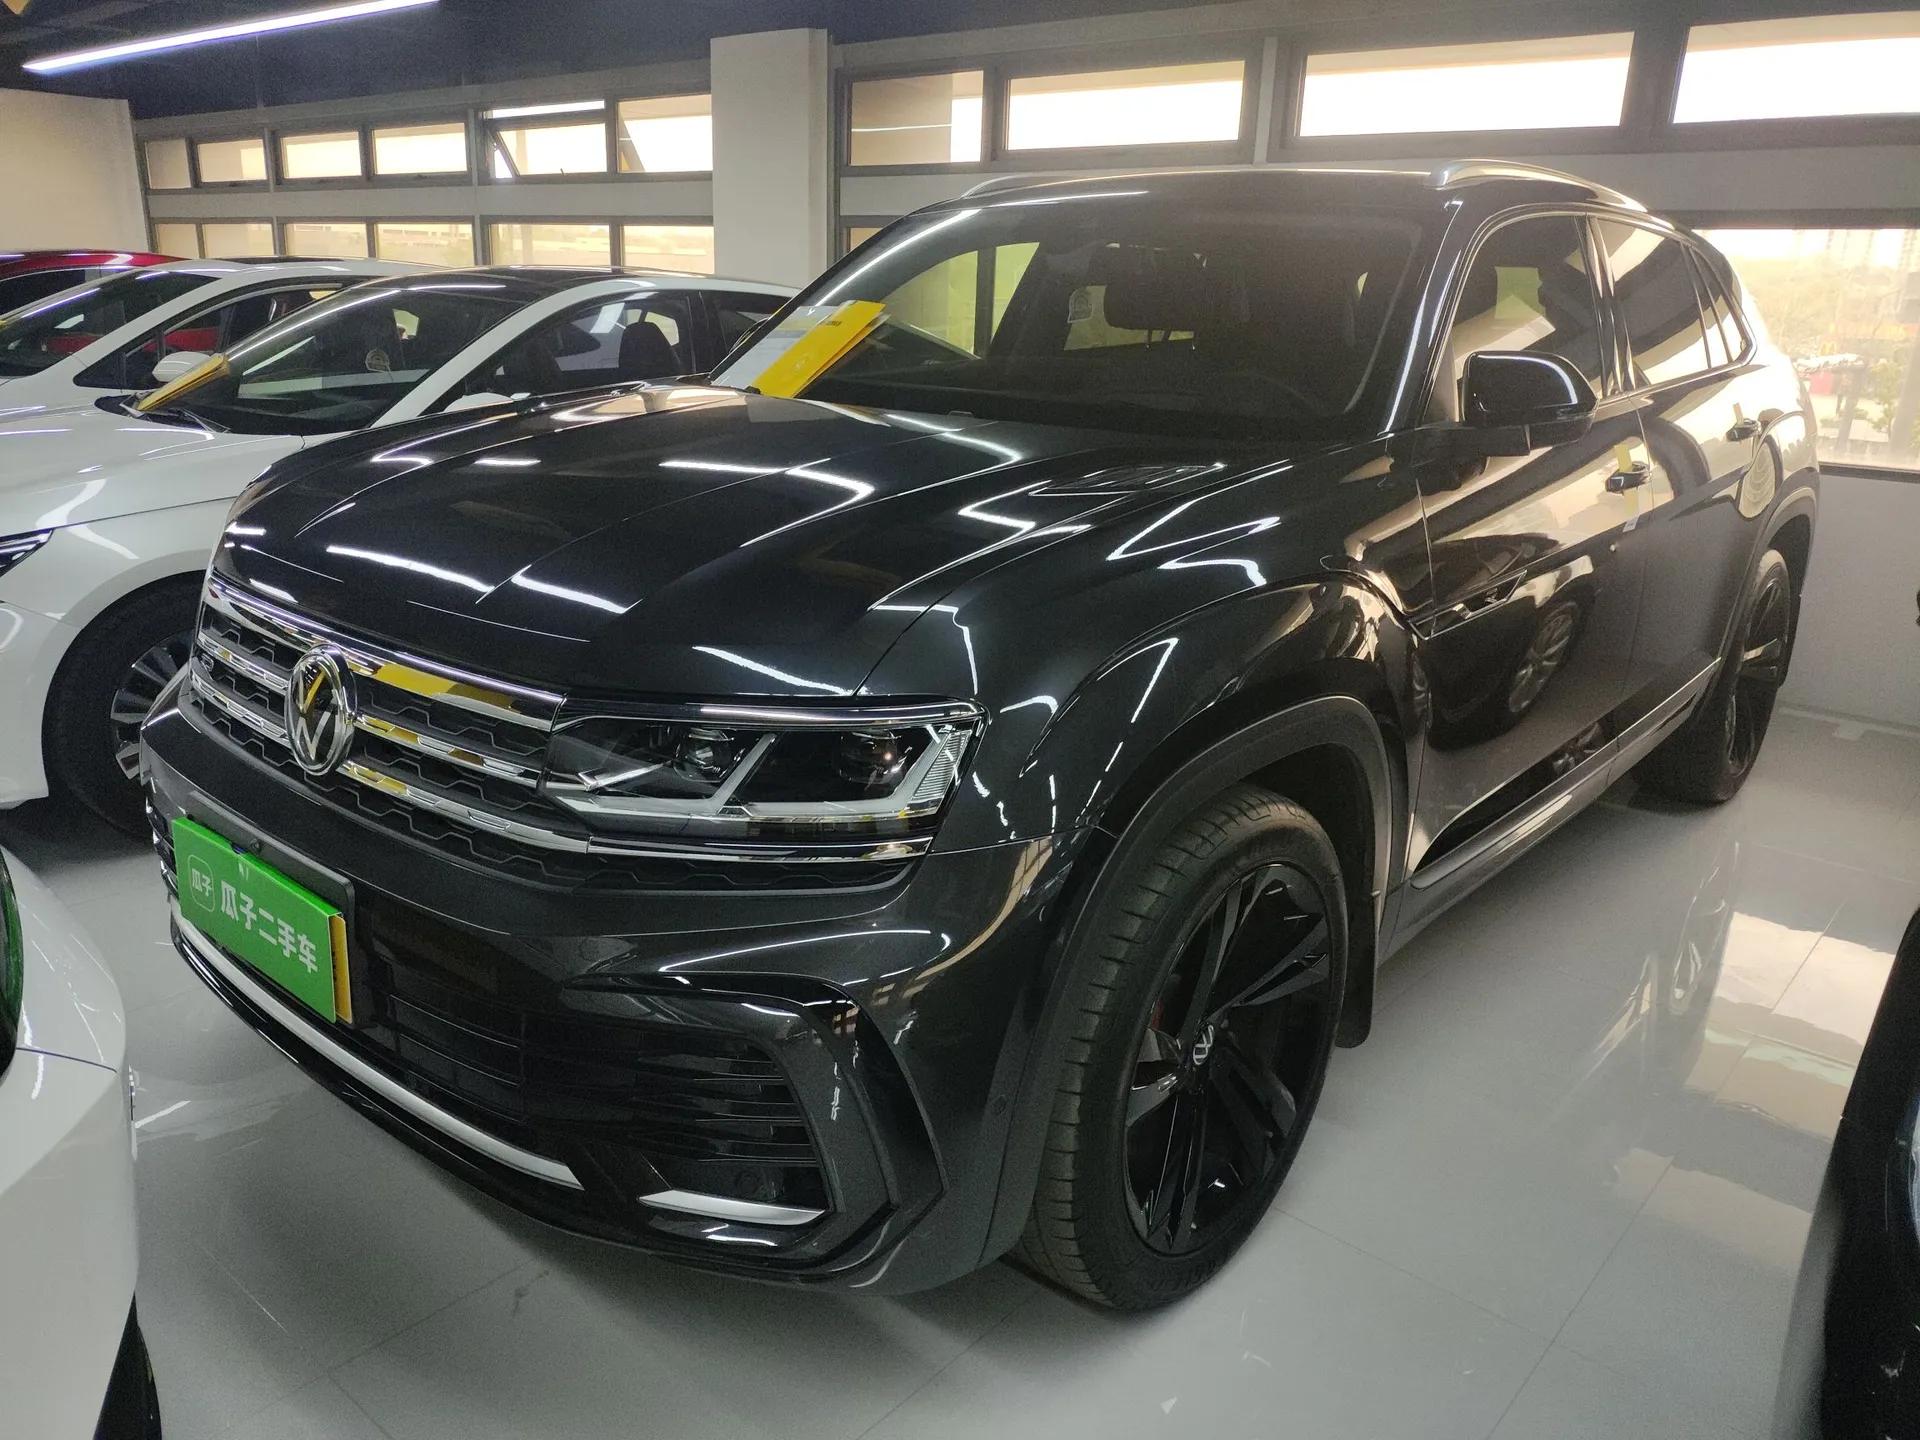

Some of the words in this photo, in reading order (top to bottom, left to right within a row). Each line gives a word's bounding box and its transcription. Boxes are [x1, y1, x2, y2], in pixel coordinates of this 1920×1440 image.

[191, 868, 212, 897] 瓜子
[220, 880, 319, 974] 瓜子二手车
